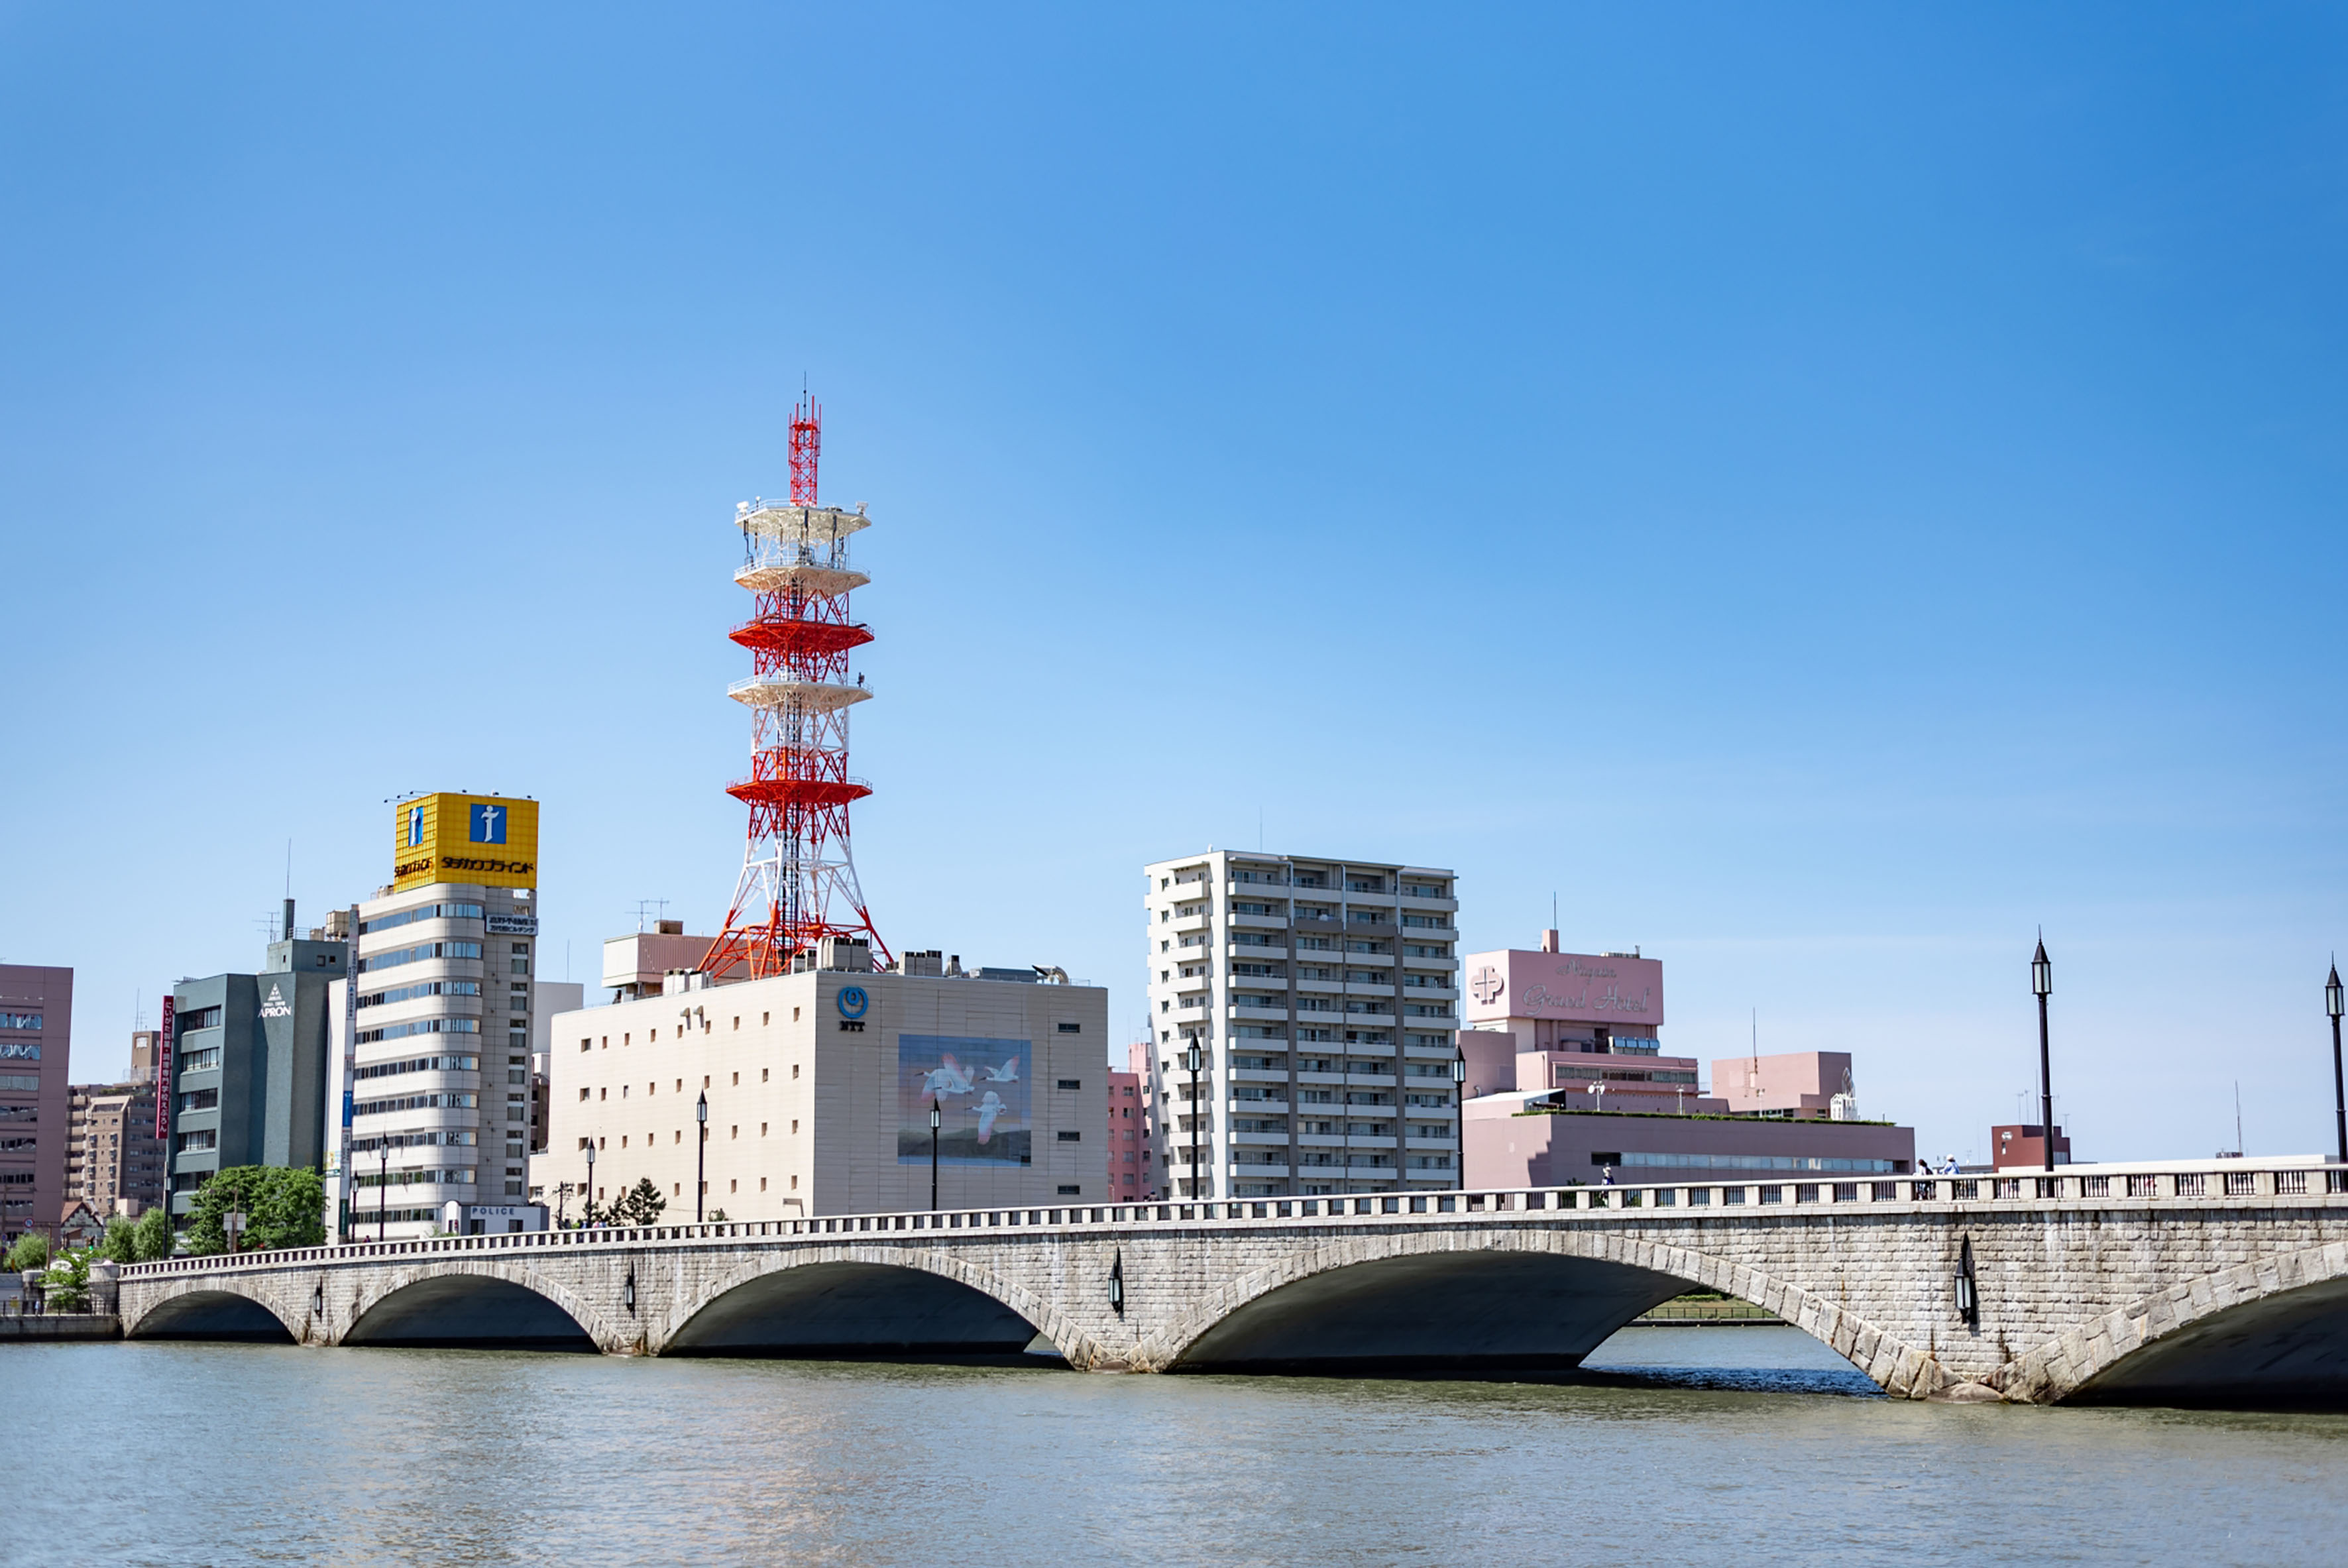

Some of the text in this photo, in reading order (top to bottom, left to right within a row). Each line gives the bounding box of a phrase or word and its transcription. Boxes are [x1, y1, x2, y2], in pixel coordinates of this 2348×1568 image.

[441, 856, 533, 873] タチカワブラインド
[1524, 981, 1651, 1016] Grand Hotel
[258, 1006, 292, 1018] APRON
[840, 1020, 866, 1032] NTT
[472, 1207, 515, 1215] POLICE
